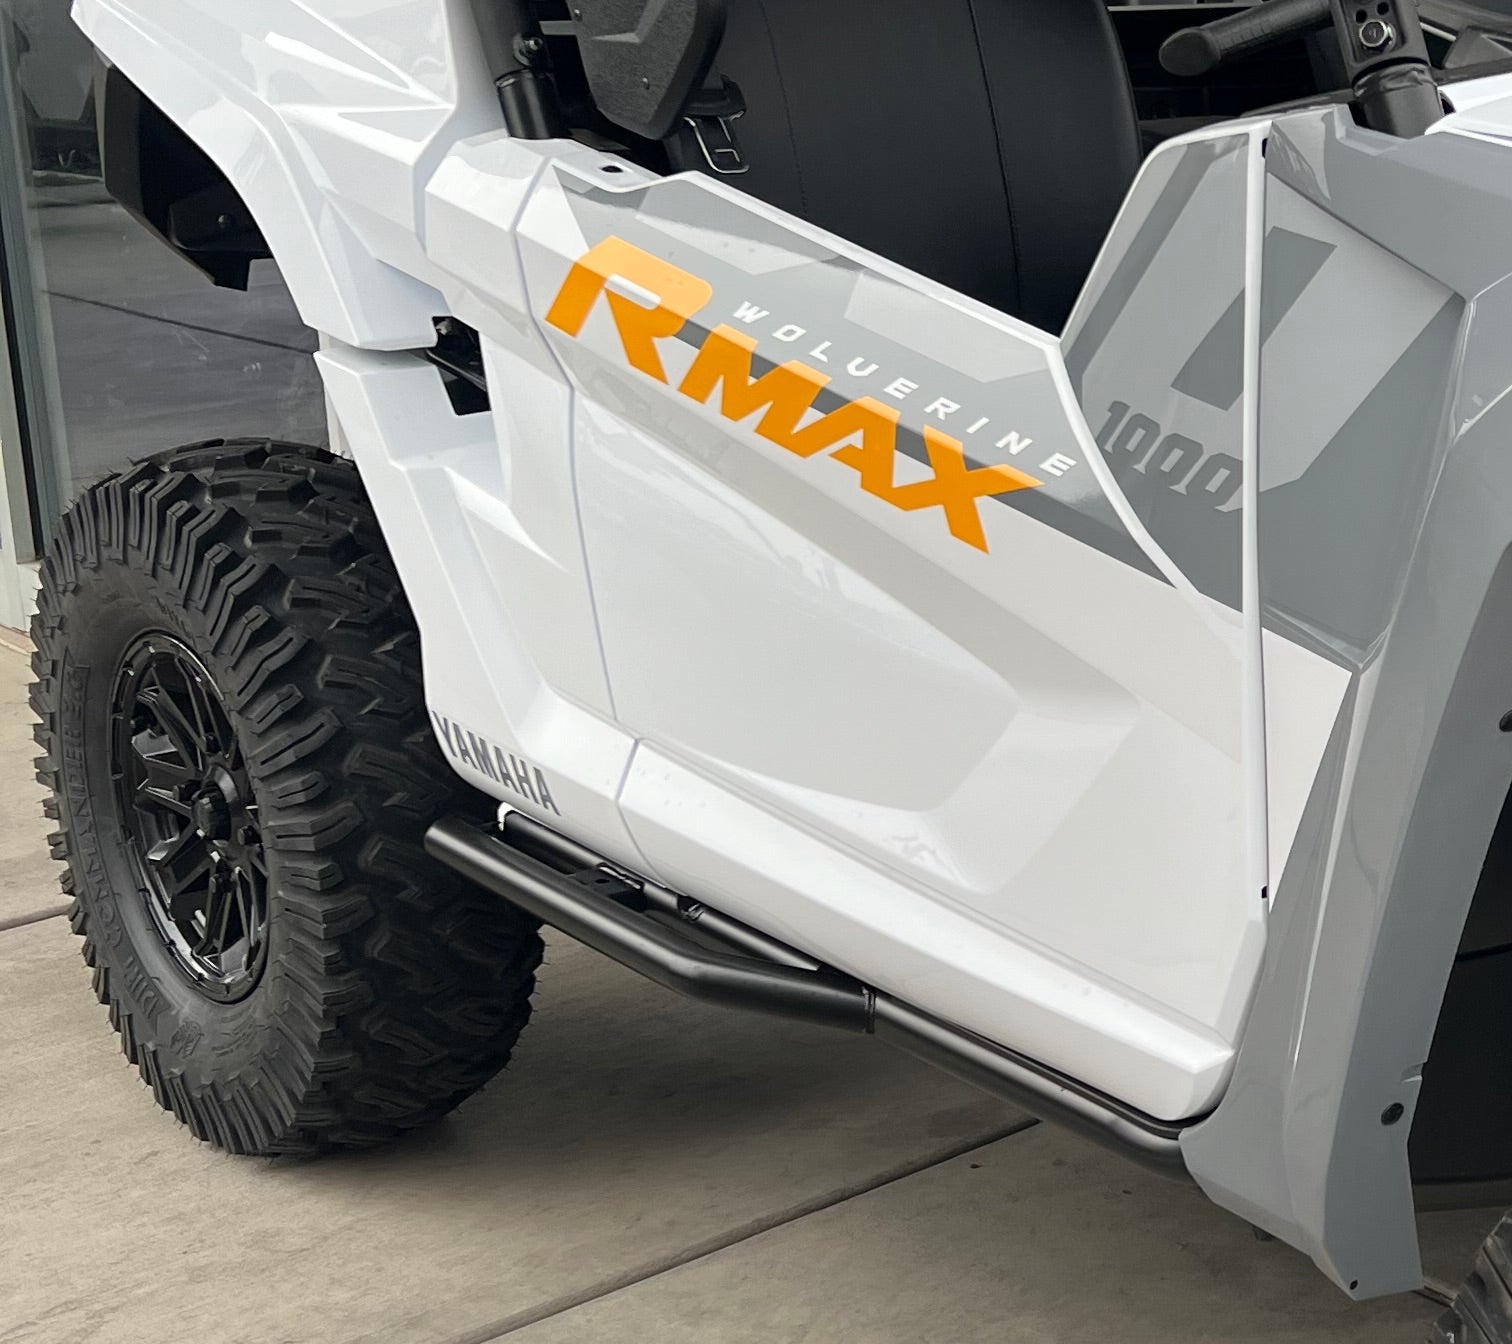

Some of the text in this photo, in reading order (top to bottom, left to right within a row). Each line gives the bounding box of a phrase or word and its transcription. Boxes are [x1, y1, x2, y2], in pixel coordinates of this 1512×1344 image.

[544, 235, 1045, 554] RMAX
[733, 301, 1077, 477] WOLVERINE
[1097, 400, 1243, 513] 1000
[432, 709, 561, 817] YAMAHA
